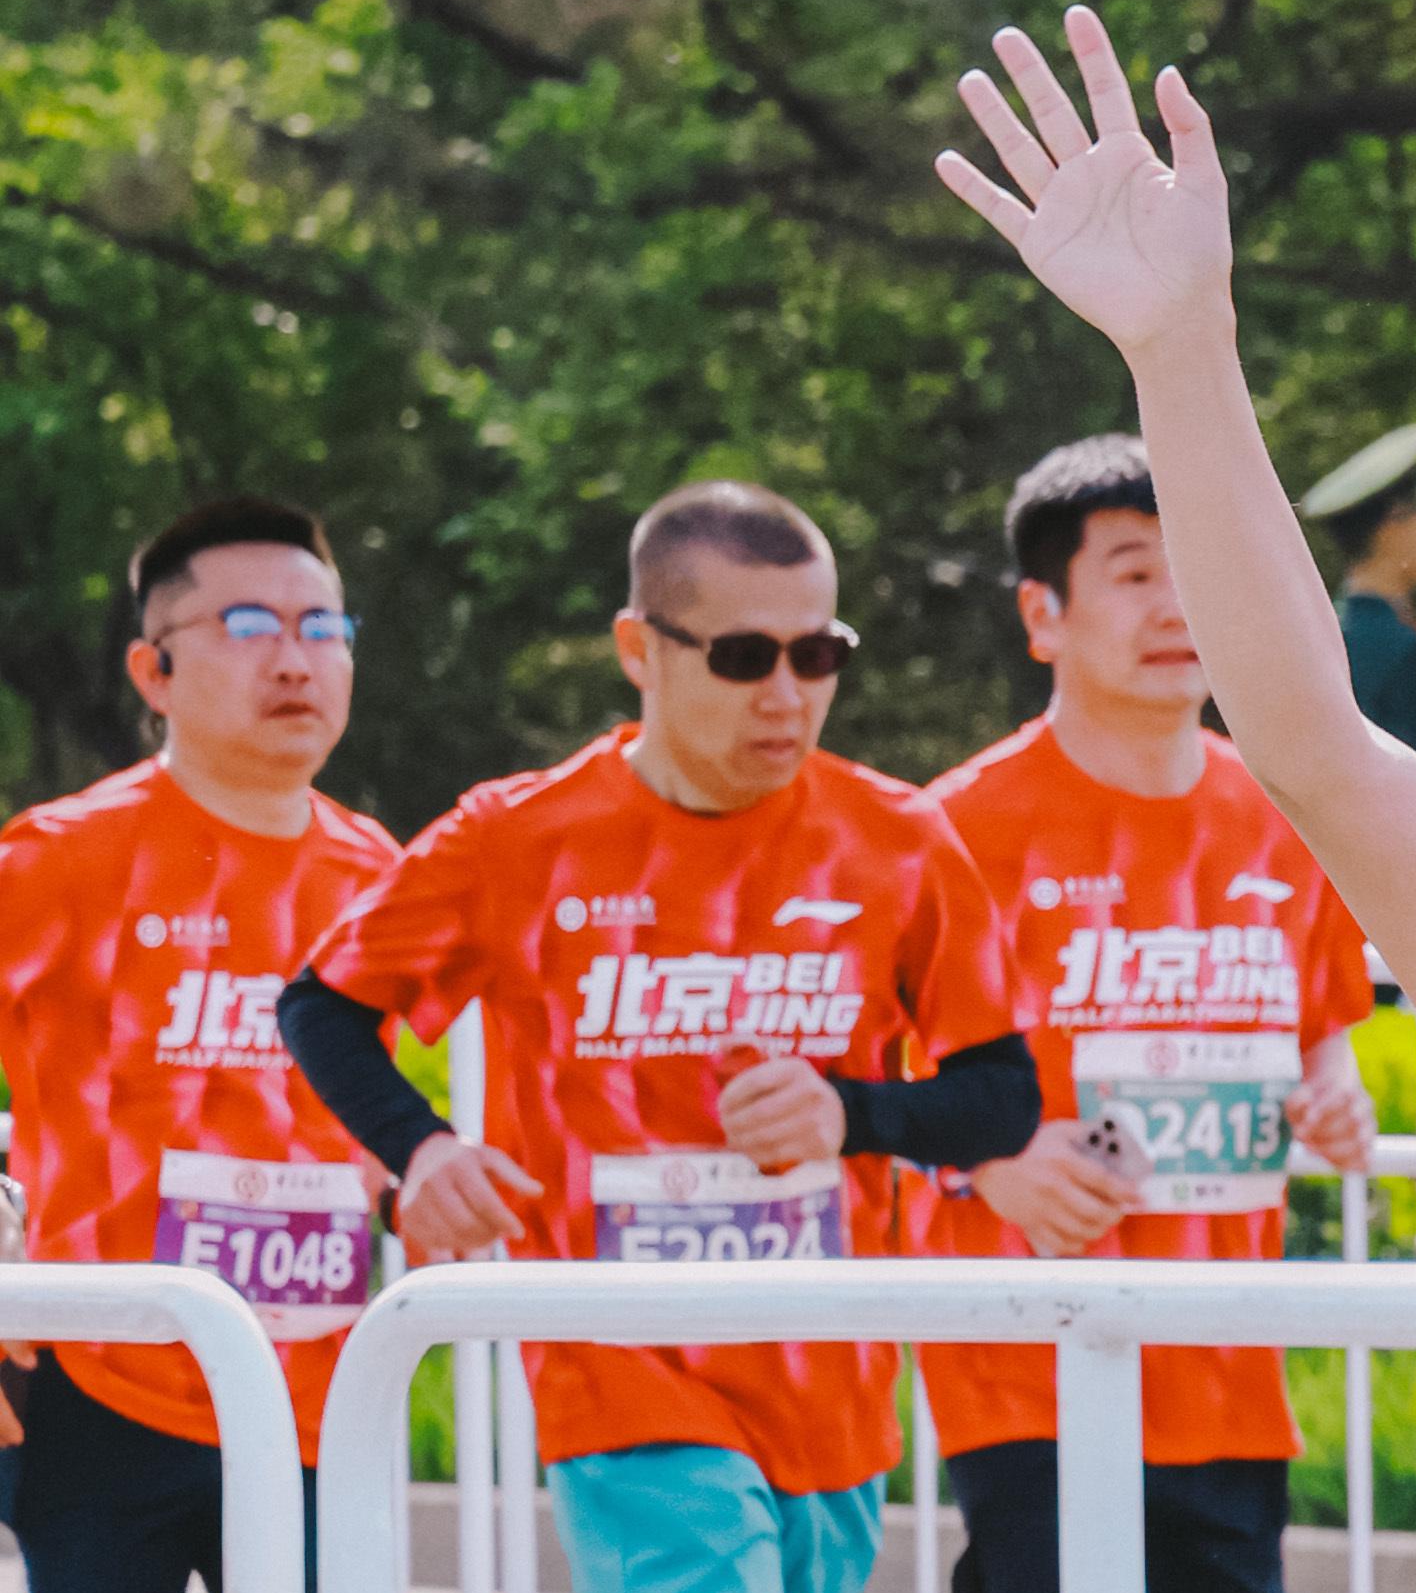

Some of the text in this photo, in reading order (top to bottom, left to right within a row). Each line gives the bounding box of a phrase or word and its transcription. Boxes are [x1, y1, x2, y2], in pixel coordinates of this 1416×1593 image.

[575, 952, 746, 1038] 北京
[744, 952, 843, 993] BEI
[1051, 926, 1209, 1005] 北京
[732, 993, 865, 1036] JING
[180, 1220, 355, 1292] E1048
